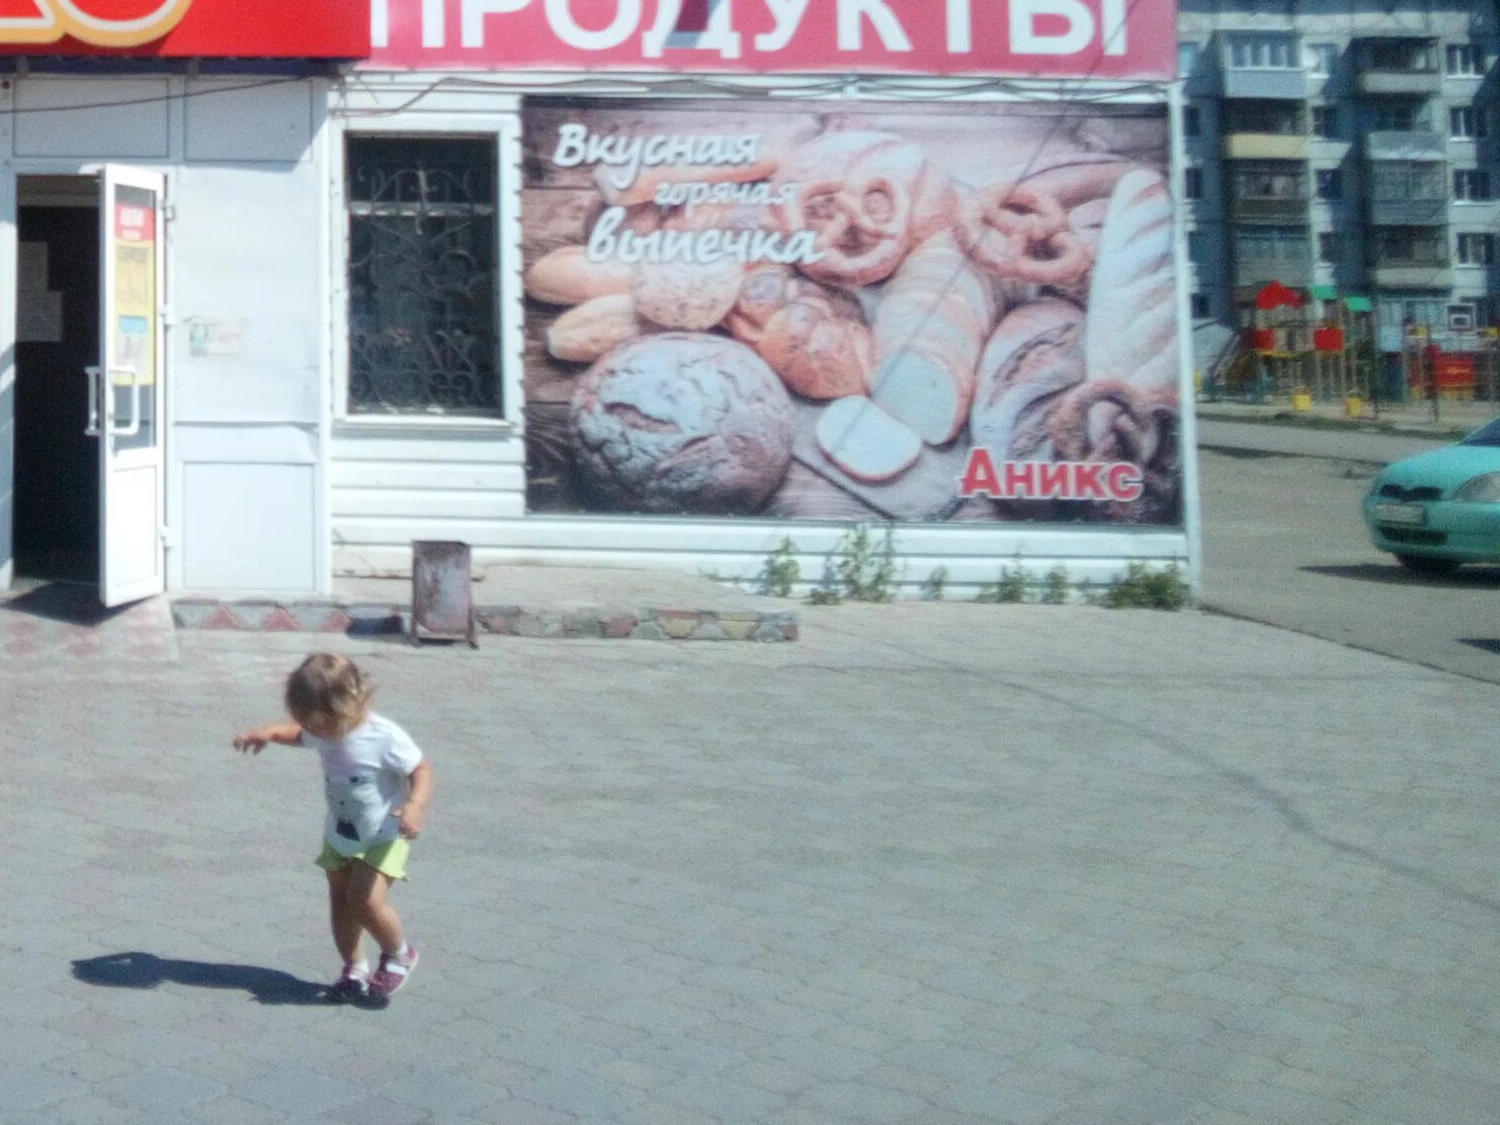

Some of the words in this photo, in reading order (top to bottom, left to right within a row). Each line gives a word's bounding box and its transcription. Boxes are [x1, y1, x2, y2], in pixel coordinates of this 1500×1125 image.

[552, 123, 762, 190] Вкусная
[653, 180, 799, 210] горячая
[587, 216, 824, 265] выпечка
[958, 450, 1144, 502] Аникс
